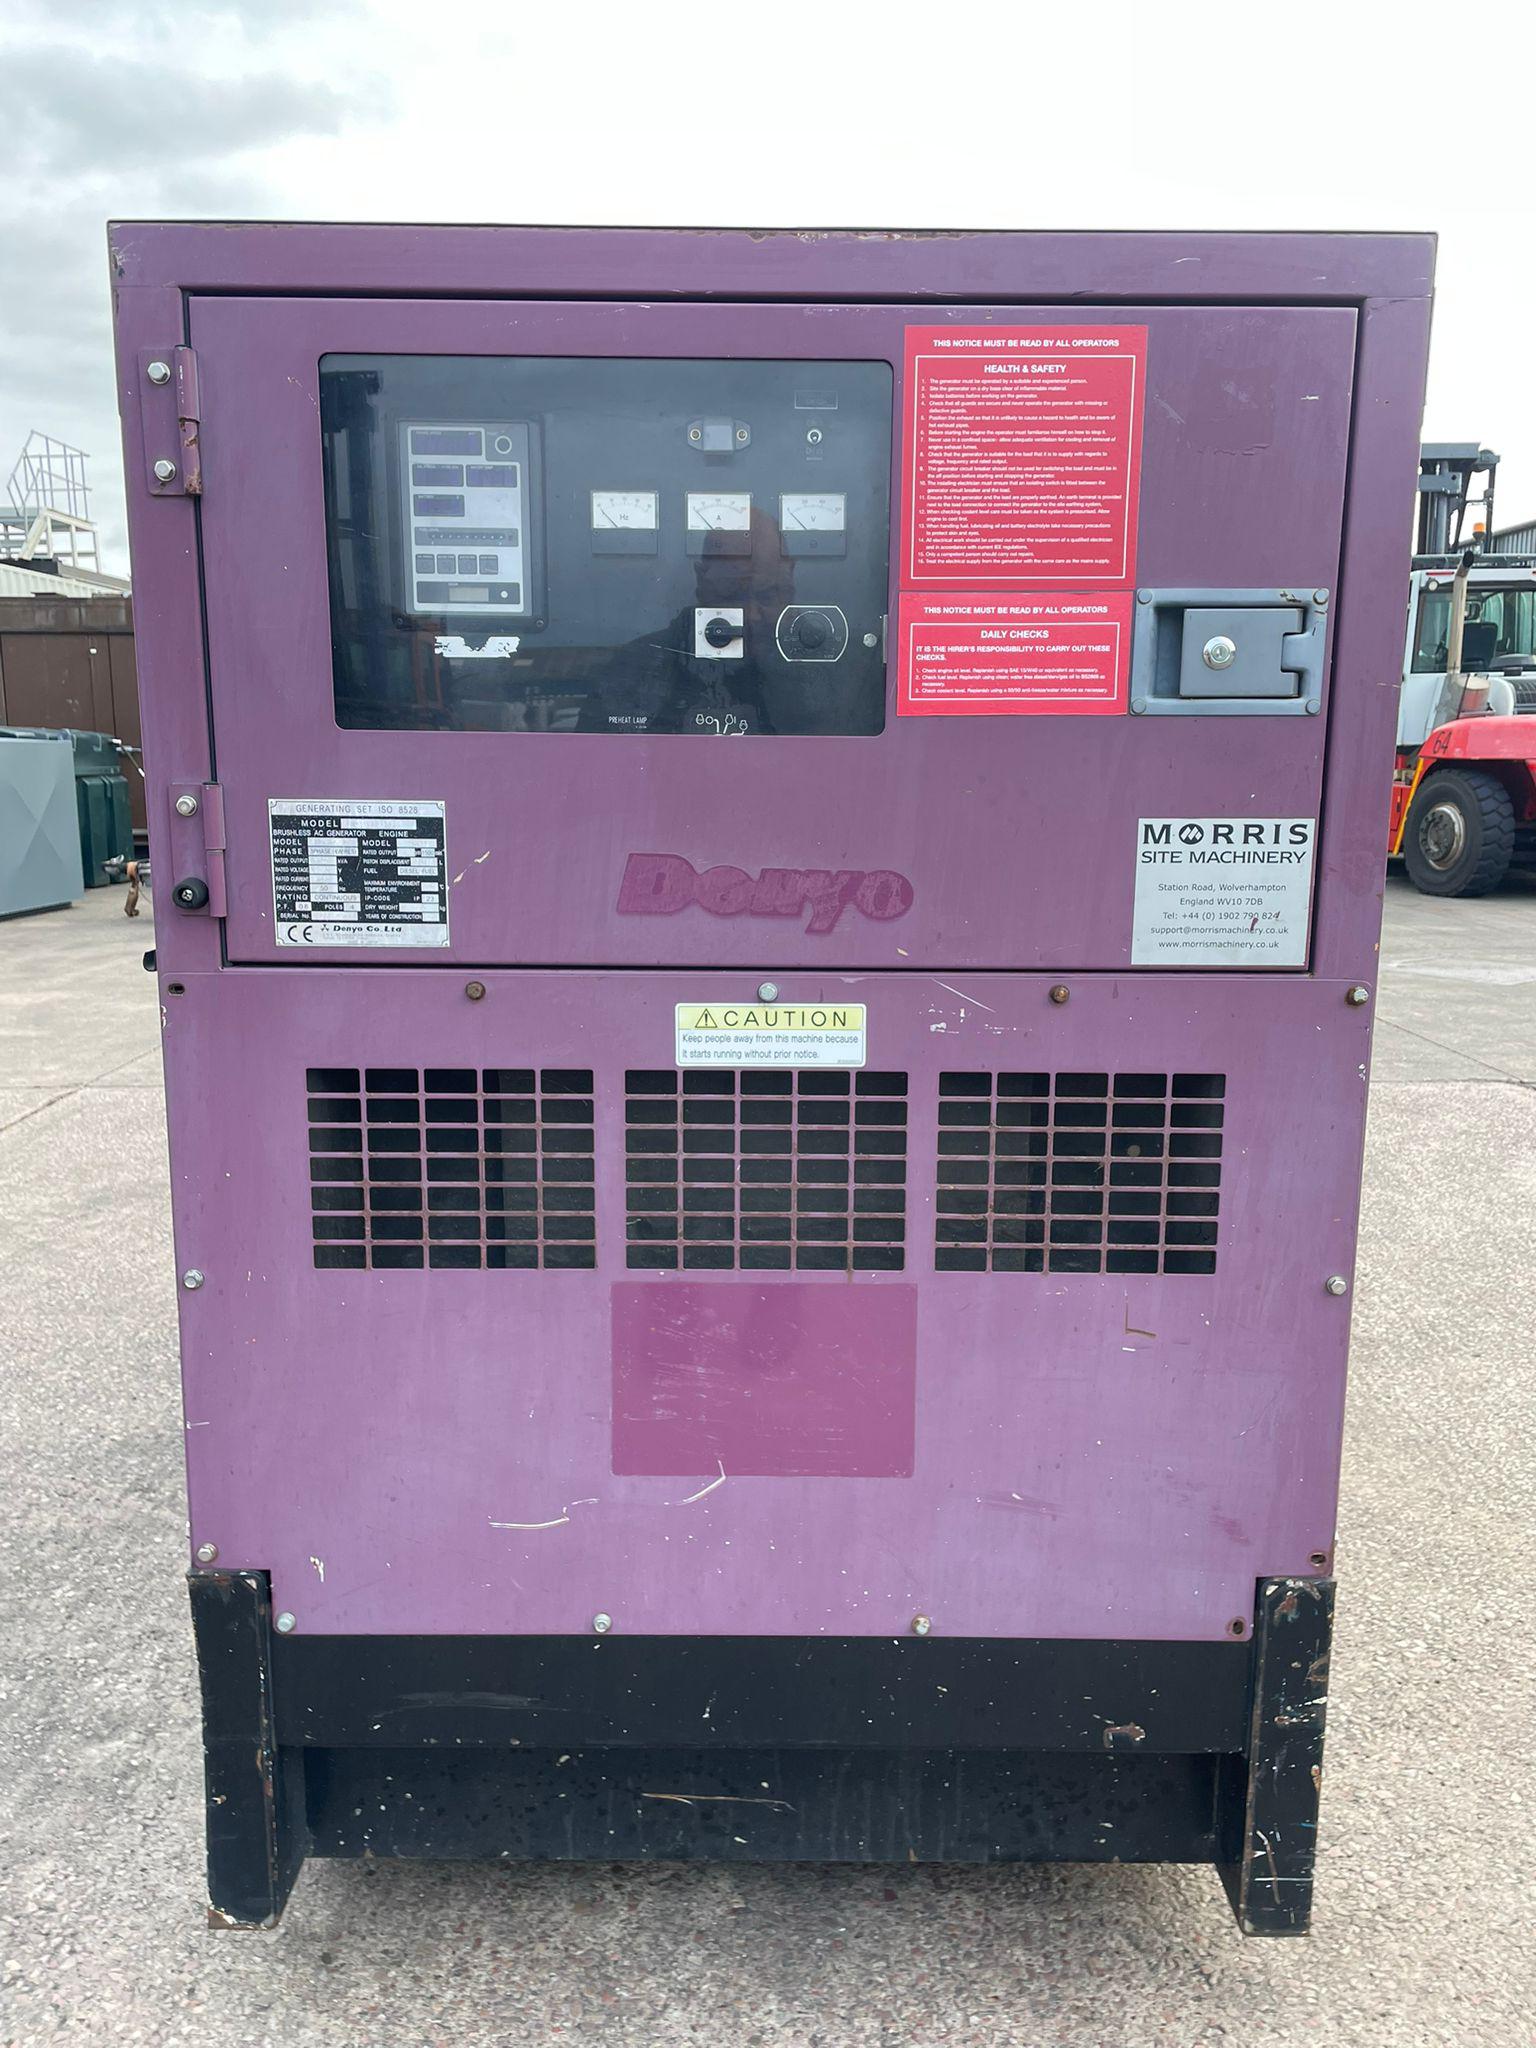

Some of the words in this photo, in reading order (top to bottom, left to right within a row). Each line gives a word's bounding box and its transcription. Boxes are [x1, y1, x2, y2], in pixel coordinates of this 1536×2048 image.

[934, 339, 951, 347] THIS
[953, 339, 981, 347] NOTICE
[984, 339, 1006, 347] MUST
[1008, 339, 1018, 347] BE
[1020, 339, 1041, 347] READ
[1044, 339, 1054, 347] BY
[1056, 339, 1070, 347] ALL
[1072, 339, 1119, 347] OPERATORS
[984, 365, 1020, 373] HEALTH
[1022, 365, 1028, 373] &
[1031, 365, 1066, 373] SAFETY
[1009, 630, 1049, 638] CHECKS
[1433, 731, 1452, 754] 64
[379, 806, 392, 814] ISO
[1143, 824, 1308, 845] MORRIS
[1142, 851, 1182, 864] SITE
[1190, 851, 1306, 864] MACHINERY
[1192, 884, 1216, 892] Road,
[1219, 884, 1287, 892] Wolverhampton
[617, 852, 915, 934] Denyo
[1180, 898, 1214, 906] England
[1163, 912, 1178, 920] Tel:
[1202, 912, 1215, 920] (0)
[288, 925, 313, 942] CE
[334, 925, 362, 933] Denyo
[1151, 926, 1288, 935] support@morrismachinery.co.uk
[1159, 940, 1279, 949] www.morrismachinery.co.uk
[724, 1010, 847, 1027] CAUTION
[682, 1034, 703, 1044] Keep
[705, 1034, 732, 1044] people
[733, 1034, 754, 1044] away
[755, 1034, 773, 1044] from
[775, 1034, 789, 1044] this
[791, 1034, 824, 1044] machine
[825, 1034, 859, 1044] because
[689, 1049, 711, 1059] starts
[713, 1049, 742, 1059] running
[744, 1049, 772, 1059] without
[774, 1049, 791, 1059] prior
[793, 1049, 819, 1059] notice.
